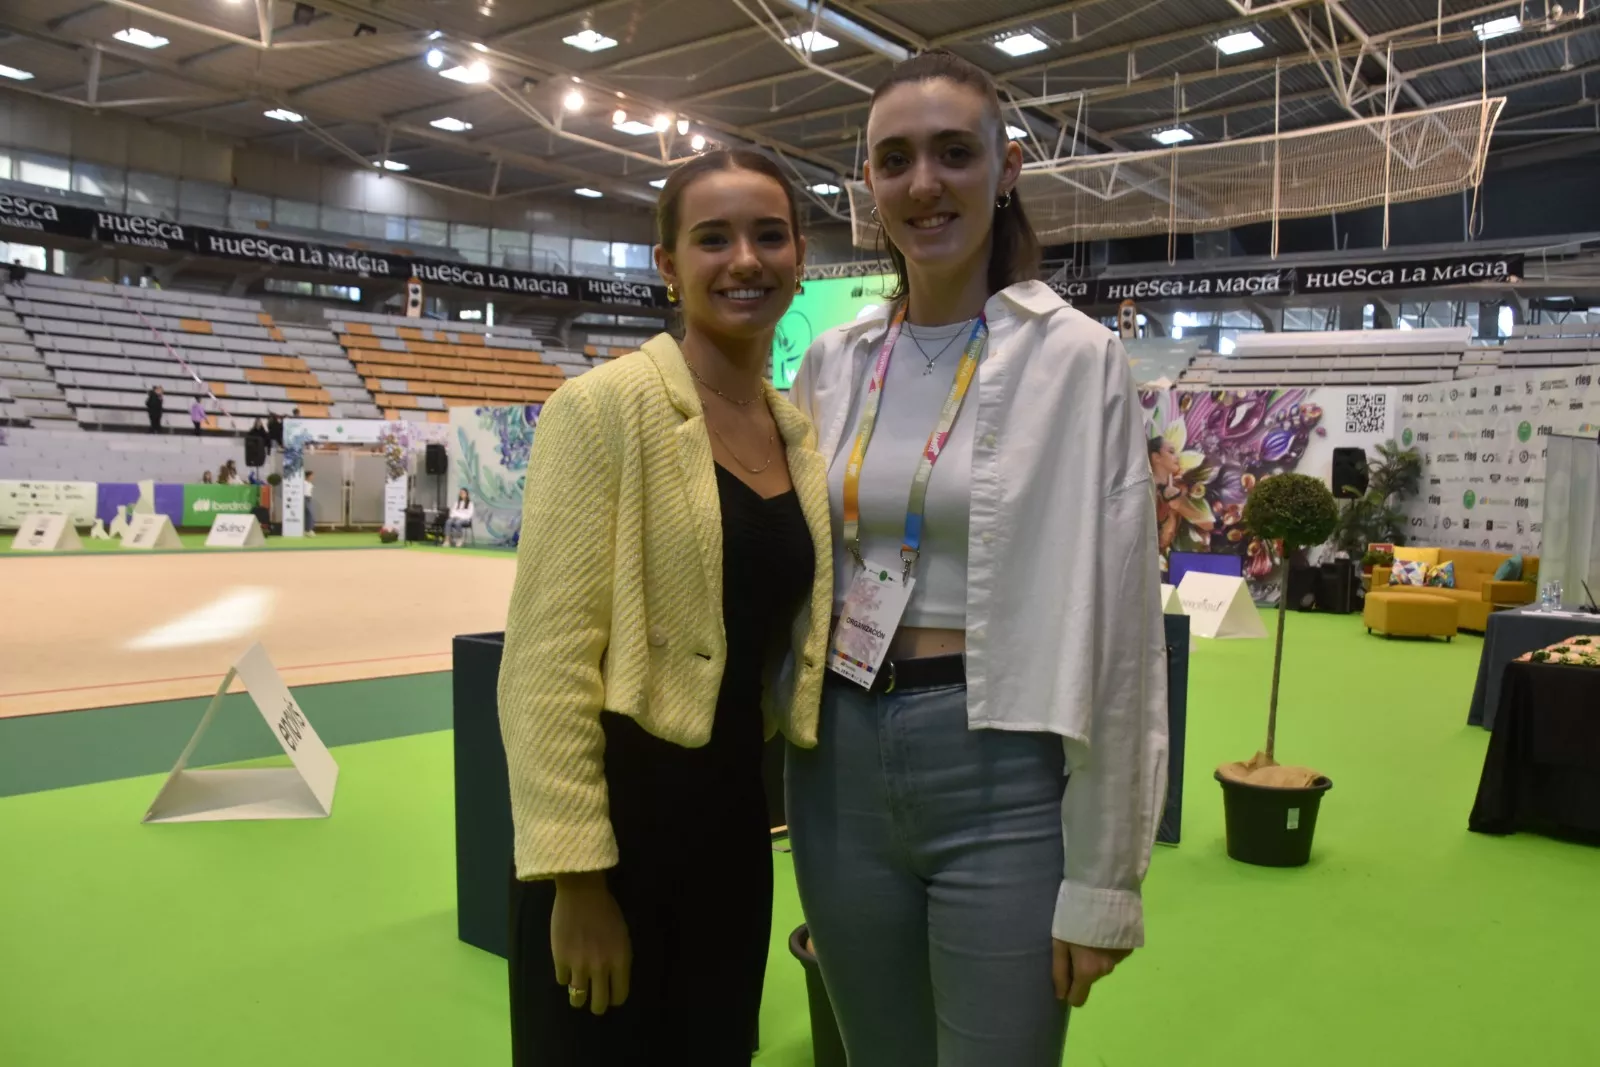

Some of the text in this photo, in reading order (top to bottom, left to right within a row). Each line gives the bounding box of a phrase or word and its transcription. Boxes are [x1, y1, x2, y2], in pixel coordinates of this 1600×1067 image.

[98, 212, 184, 241] Huesca
[209, 235, 295, 262] Huesca
[300, 248, 324, 265] La
[411, 263, 484, 286] Huesca
[488, 273, 510, 289] La
[1306, 268, 1394, 289] Huesca
[1400, 267, 1426, 283] La
[588, 280, 652, 298] Huesca
[1107, 279, 1183, 299] Huesca
[1188, 279, 1211, 294] La
[846, 616, 886, 640] ORGANIZACIÓN
